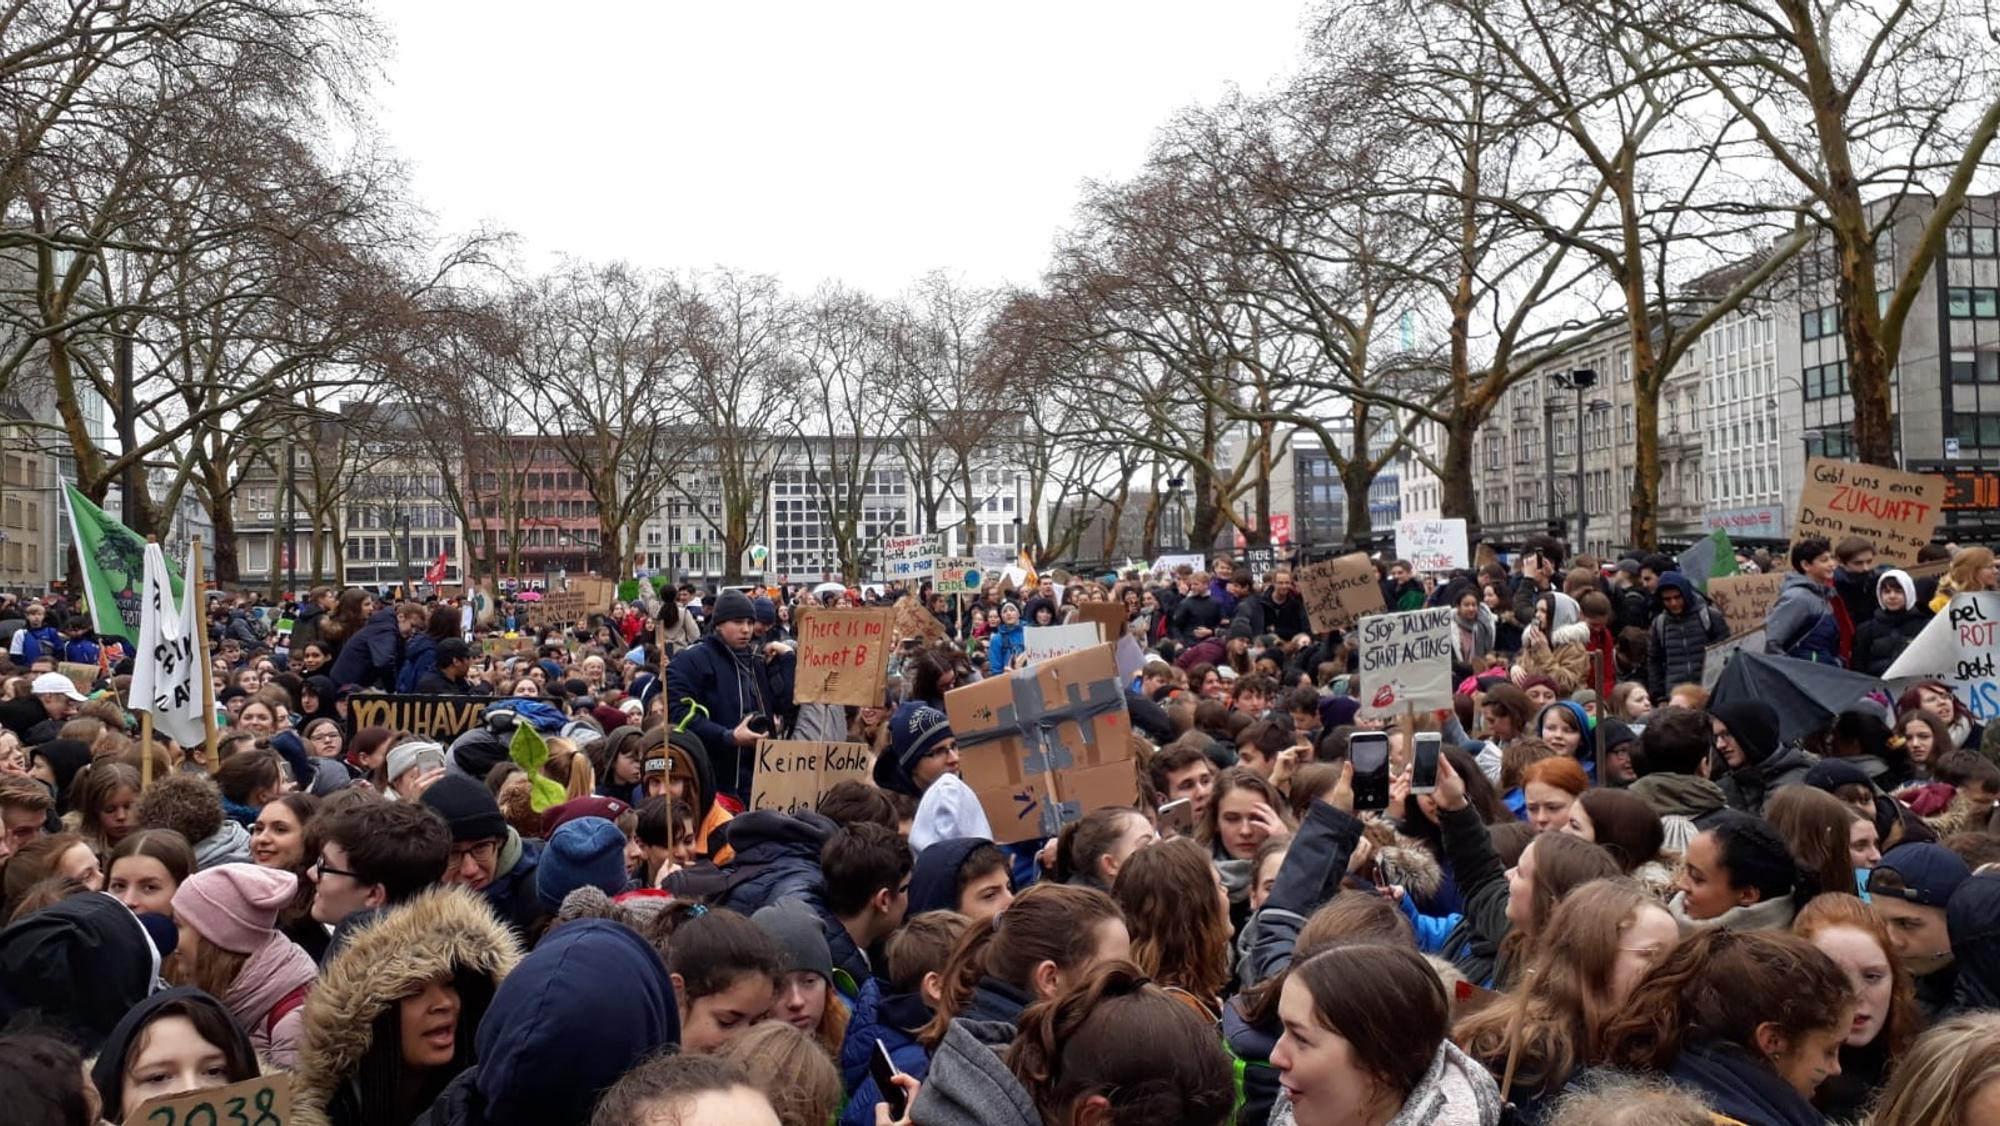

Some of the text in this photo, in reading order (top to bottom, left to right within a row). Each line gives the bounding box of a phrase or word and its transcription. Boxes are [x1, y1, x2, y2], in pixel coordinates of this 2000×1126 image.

[1852, 475, 1879, 490] uns
[1889, 482, 1924, 496] eine
[1828, 486, 1931, 524] ZUKUNFT
[1800, 508, 1925, 547] Denn wenn ihr so
[936, 560, 944, 569] Es
[1248, 550, 1271, 560] THERE
[1260, 561, 1270, 572] NO
[894, 563, 910, 574] IHR
[942, 570, 962, 580] EINE
[937, 581, 965, 592] ERDE
[805, 616, 840, 641] There
[864, 622, 881, 635] no
[1364, 610, 1450, 643] STOP TALKING
[1959, 622, 1998, 647] ROT
[803, 644, 868, 668] Planet B
[1364, 635, 1450, 671] START ACTING
[1955, 653, 1996, 680] gebt
[352, 700, 410, 731] YOU
[759, 741, 867, 773] Keine Kohle
